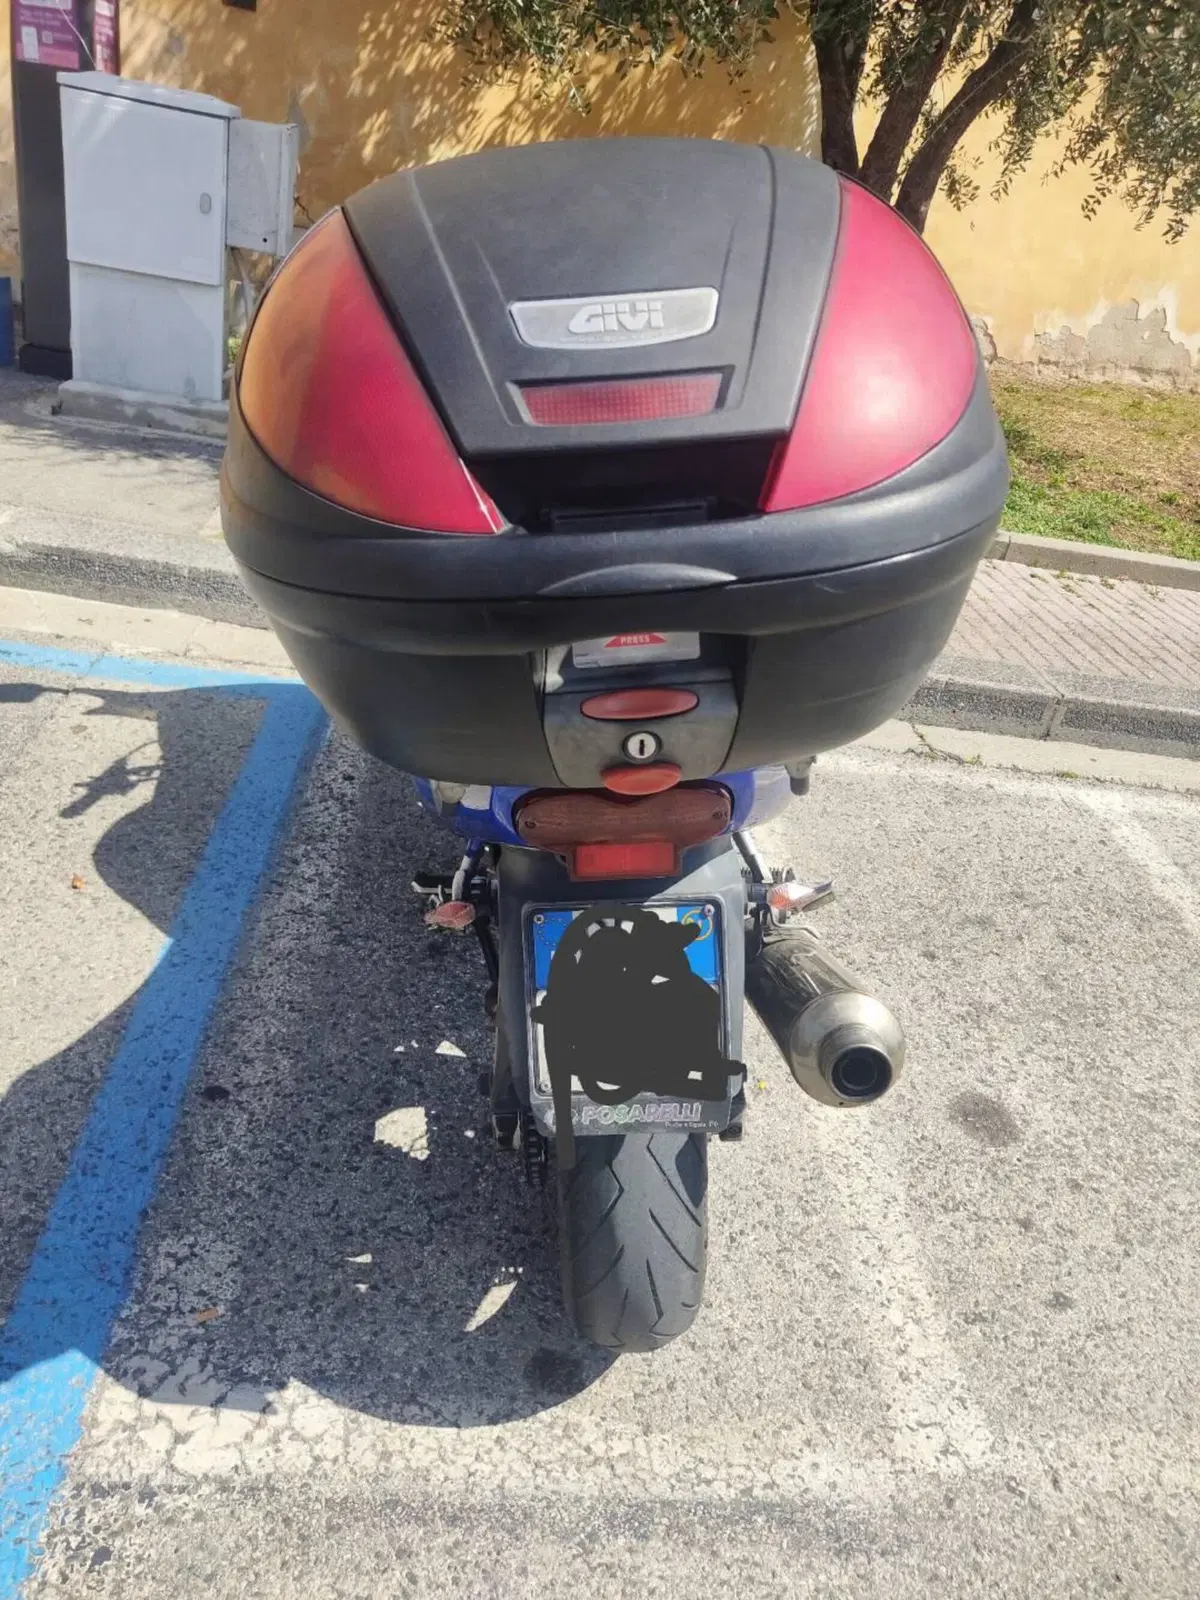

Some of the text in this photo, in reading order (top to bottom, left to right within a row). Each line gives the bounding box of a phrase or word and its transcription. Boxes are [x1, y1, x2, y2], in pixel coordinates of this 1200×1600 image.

[568, 300, 664, 334] GIVI
[620, 634, 650, 645] PRESS
[581, 1102, 701, 1125] POSARELLI
